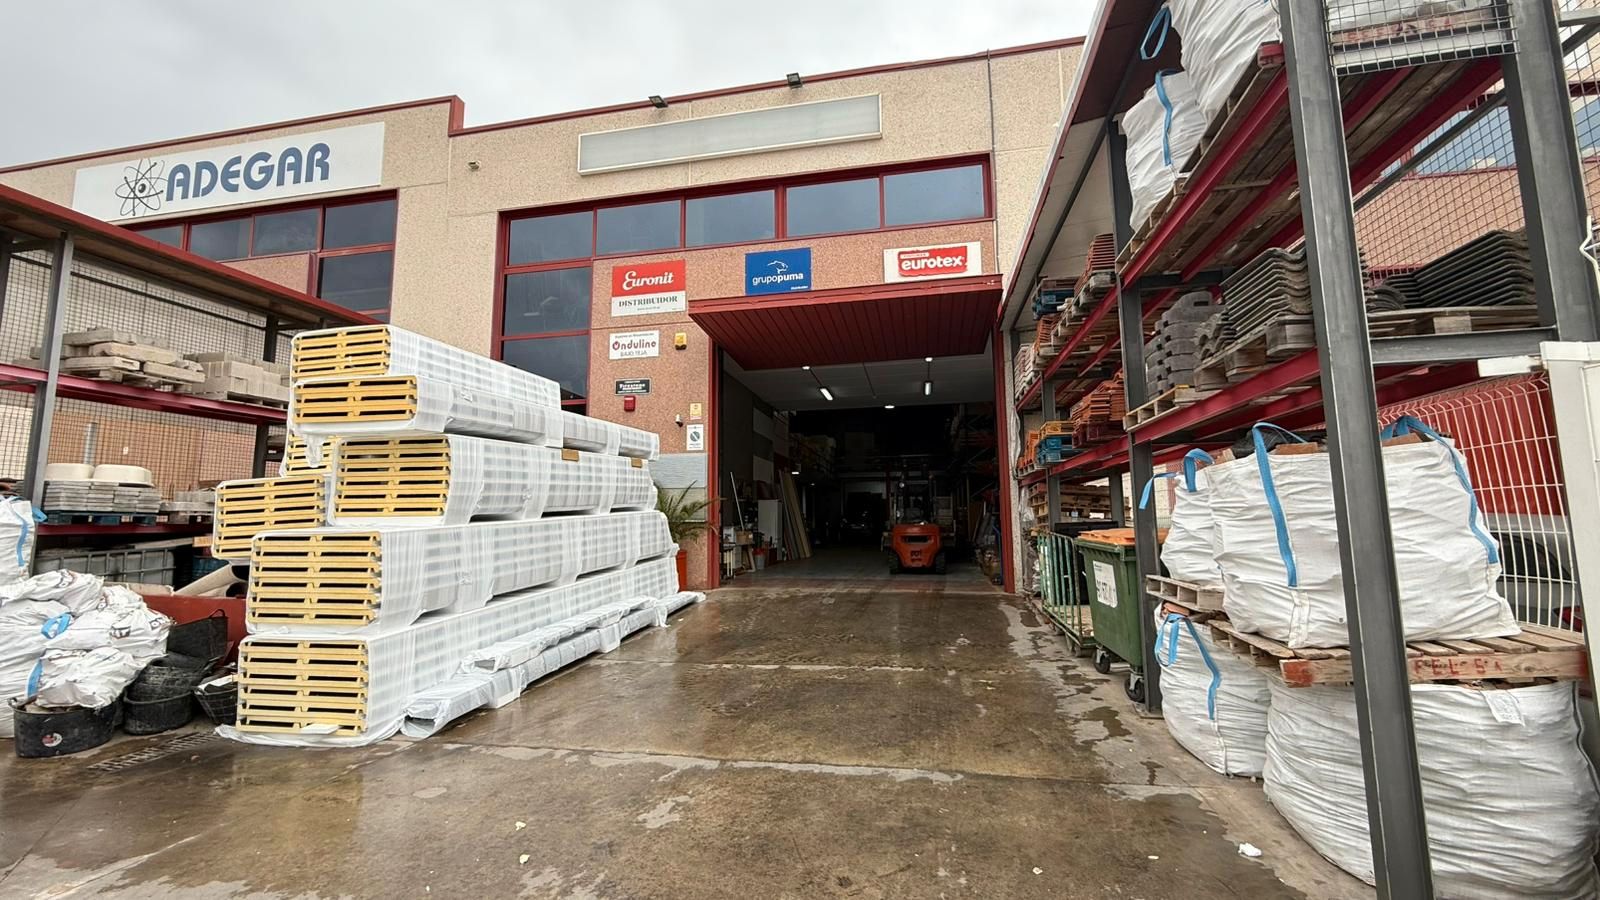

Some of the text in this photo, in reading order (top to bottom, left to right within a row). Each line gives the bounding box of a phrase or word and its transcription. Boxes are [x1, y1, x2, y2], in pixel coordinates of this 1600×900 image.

[166, 142, 331, 202] ADEGAR
[901, 255, 963, 271] eurotex
[622, 270, 674, 291] Euronit
[752, 272, 804, 286] grupopuma
[618, 296, 678, 307] DISTRIBUIDOR
